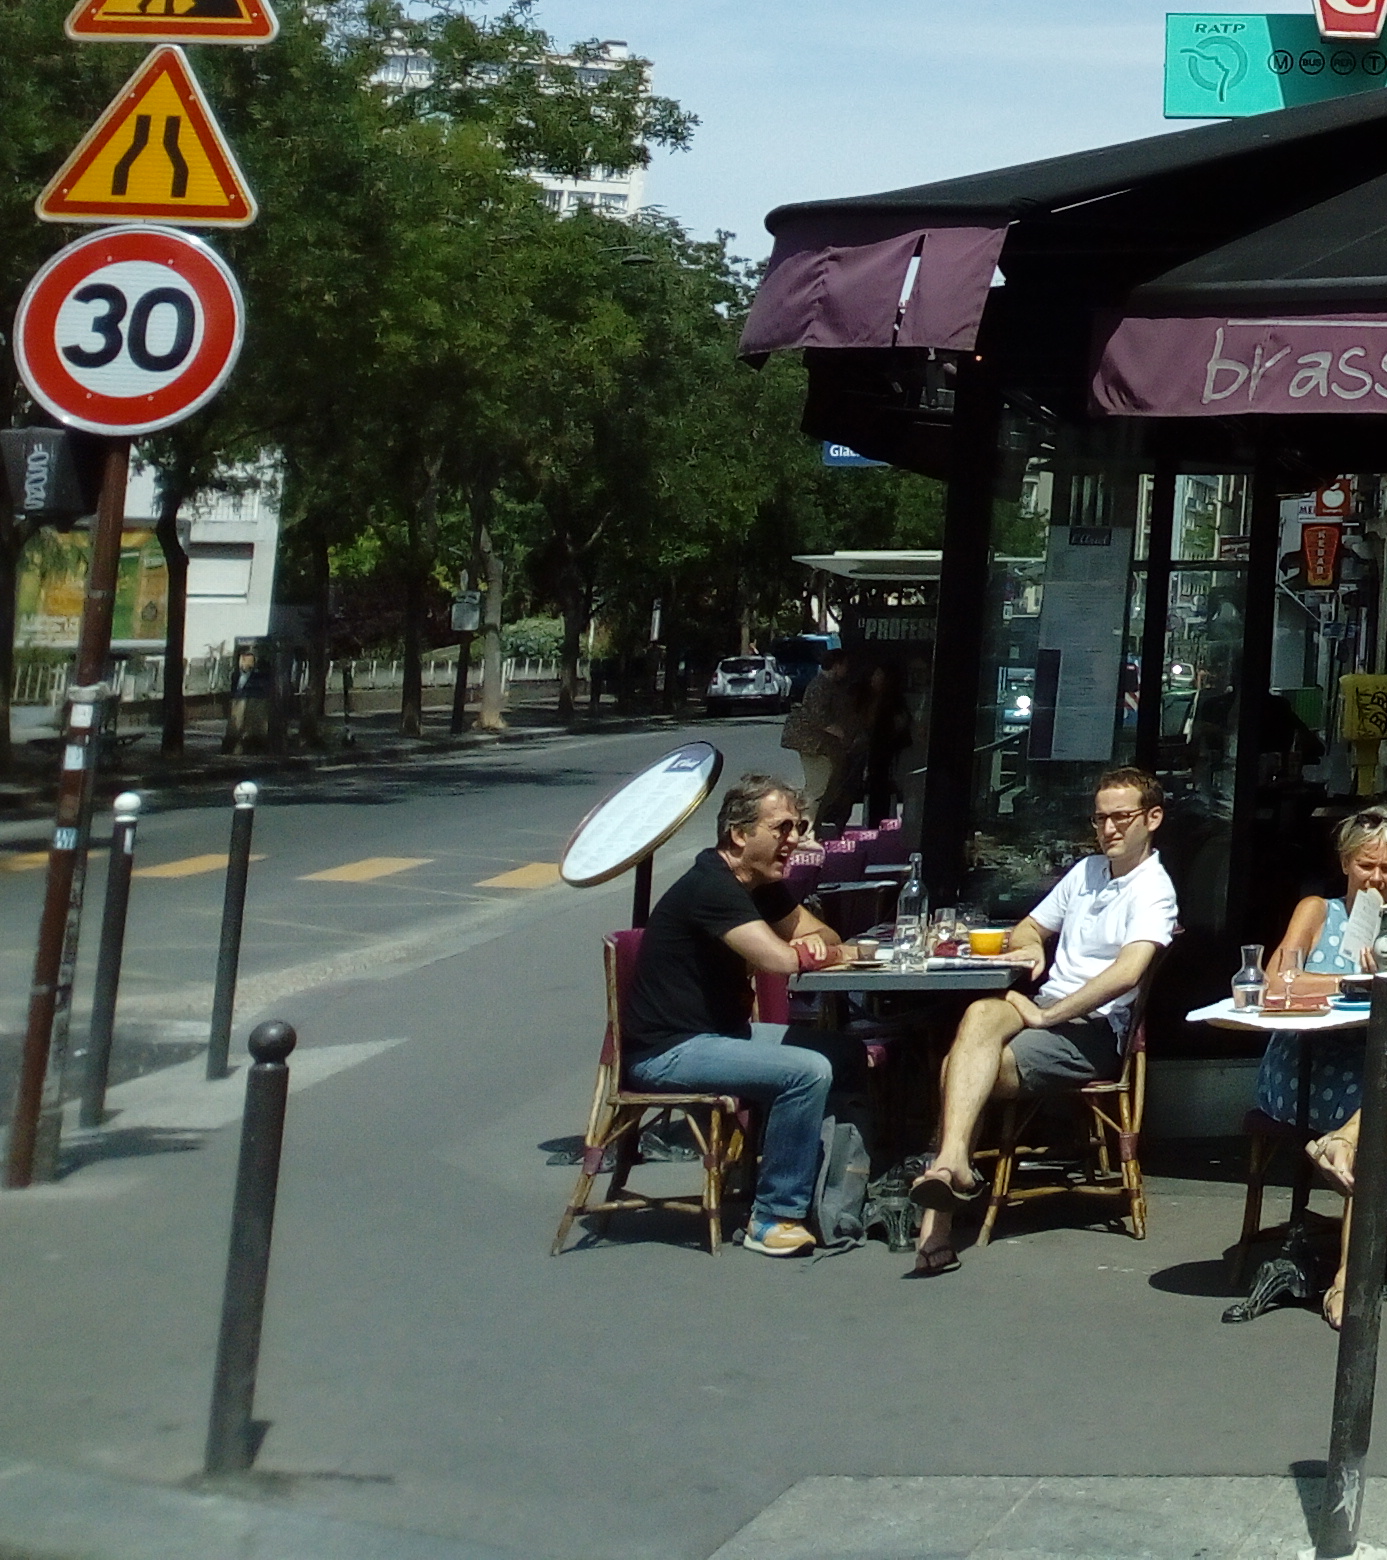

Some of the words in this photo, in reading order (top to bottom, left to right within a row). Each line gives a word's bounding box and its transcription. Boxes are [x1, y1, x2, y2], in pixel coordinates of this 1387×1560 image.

[1194, 23, 1246, 34] RATP
[1302, 57, 1322, 68] BUS
[1333, 57, 1353, 68] RER
[62, 282, 194, 373] 30
